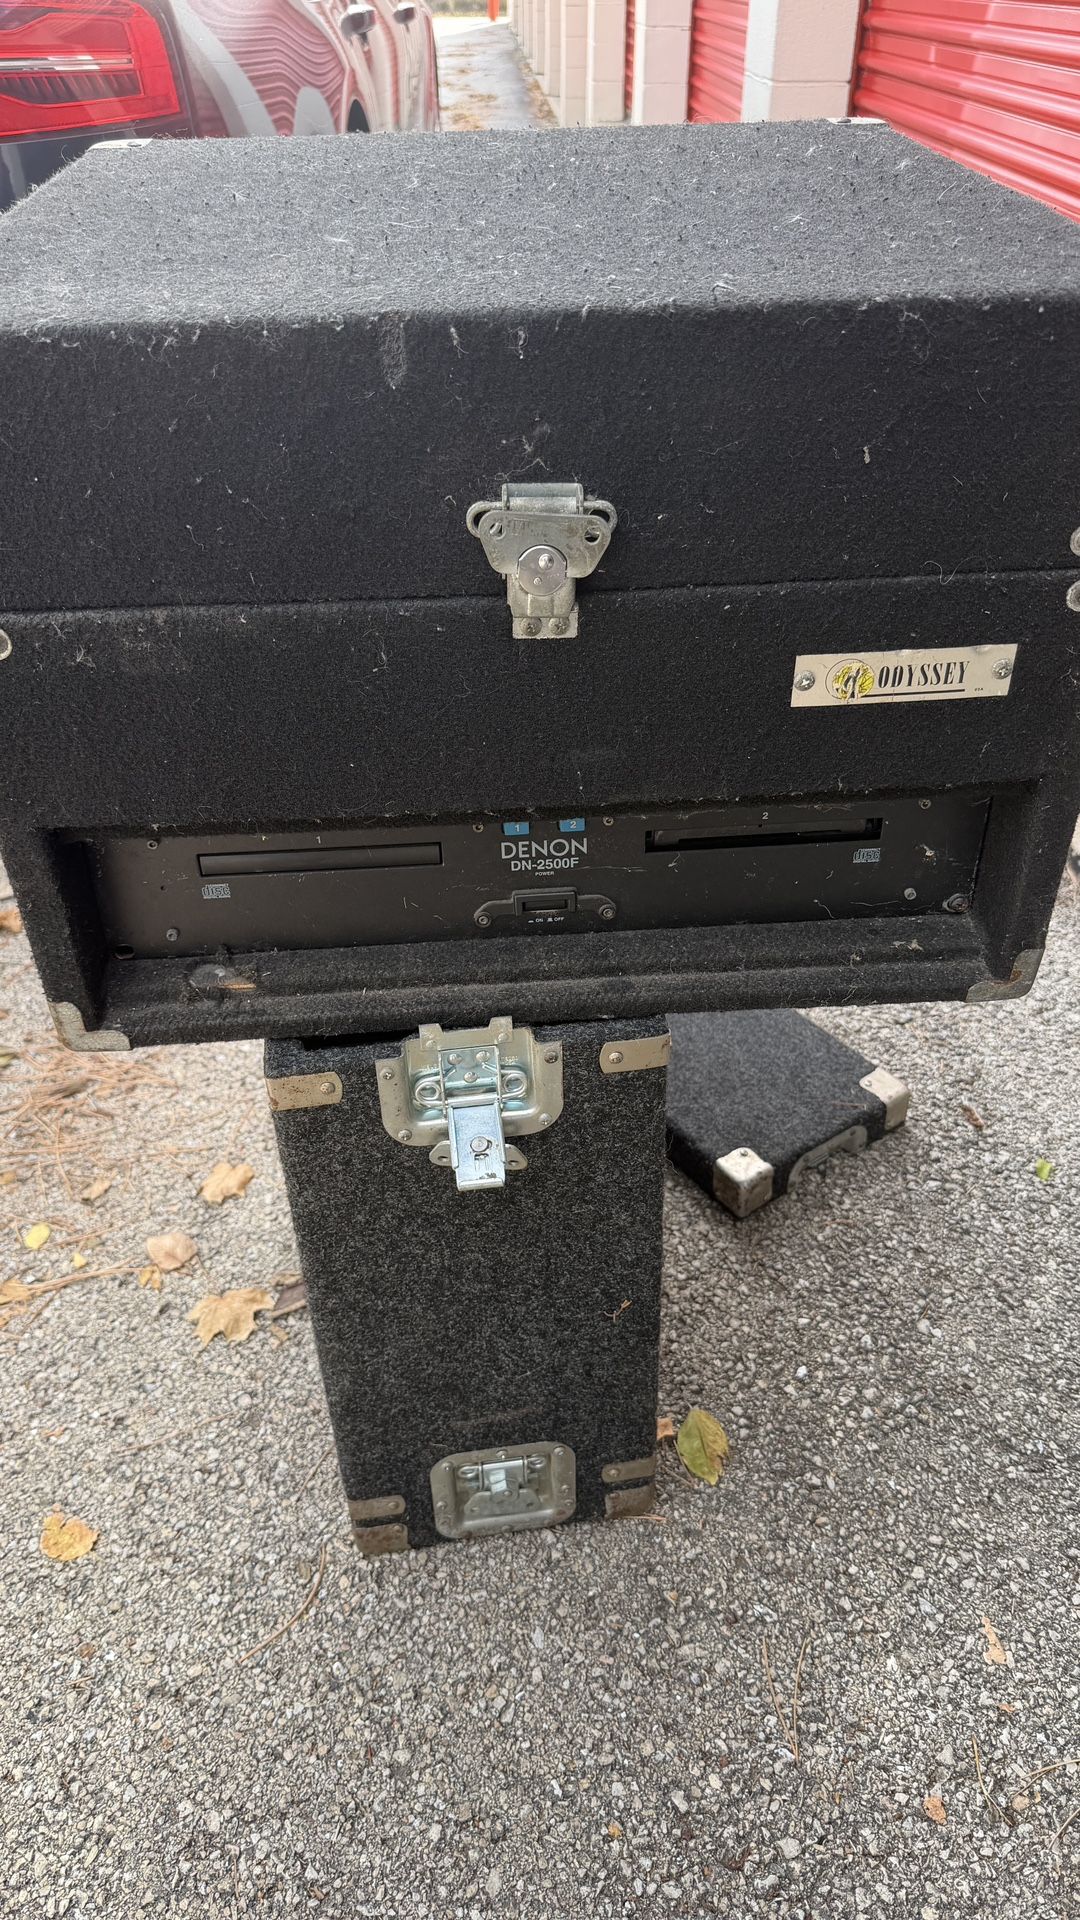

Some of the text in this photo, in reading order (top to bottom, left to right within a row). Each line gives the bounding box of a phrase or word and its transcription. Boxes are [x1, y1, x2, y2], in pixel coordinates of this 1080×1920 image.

[878, 661, 970, 688] ODYSSEY
[762, 811, 769, 820] 2
[515, 824, 521, 832] 1
[569, 821, 577, 829] 2
[501, 838, 588, 860] DENON
[511, 857, 579, 872] DN-2500F
